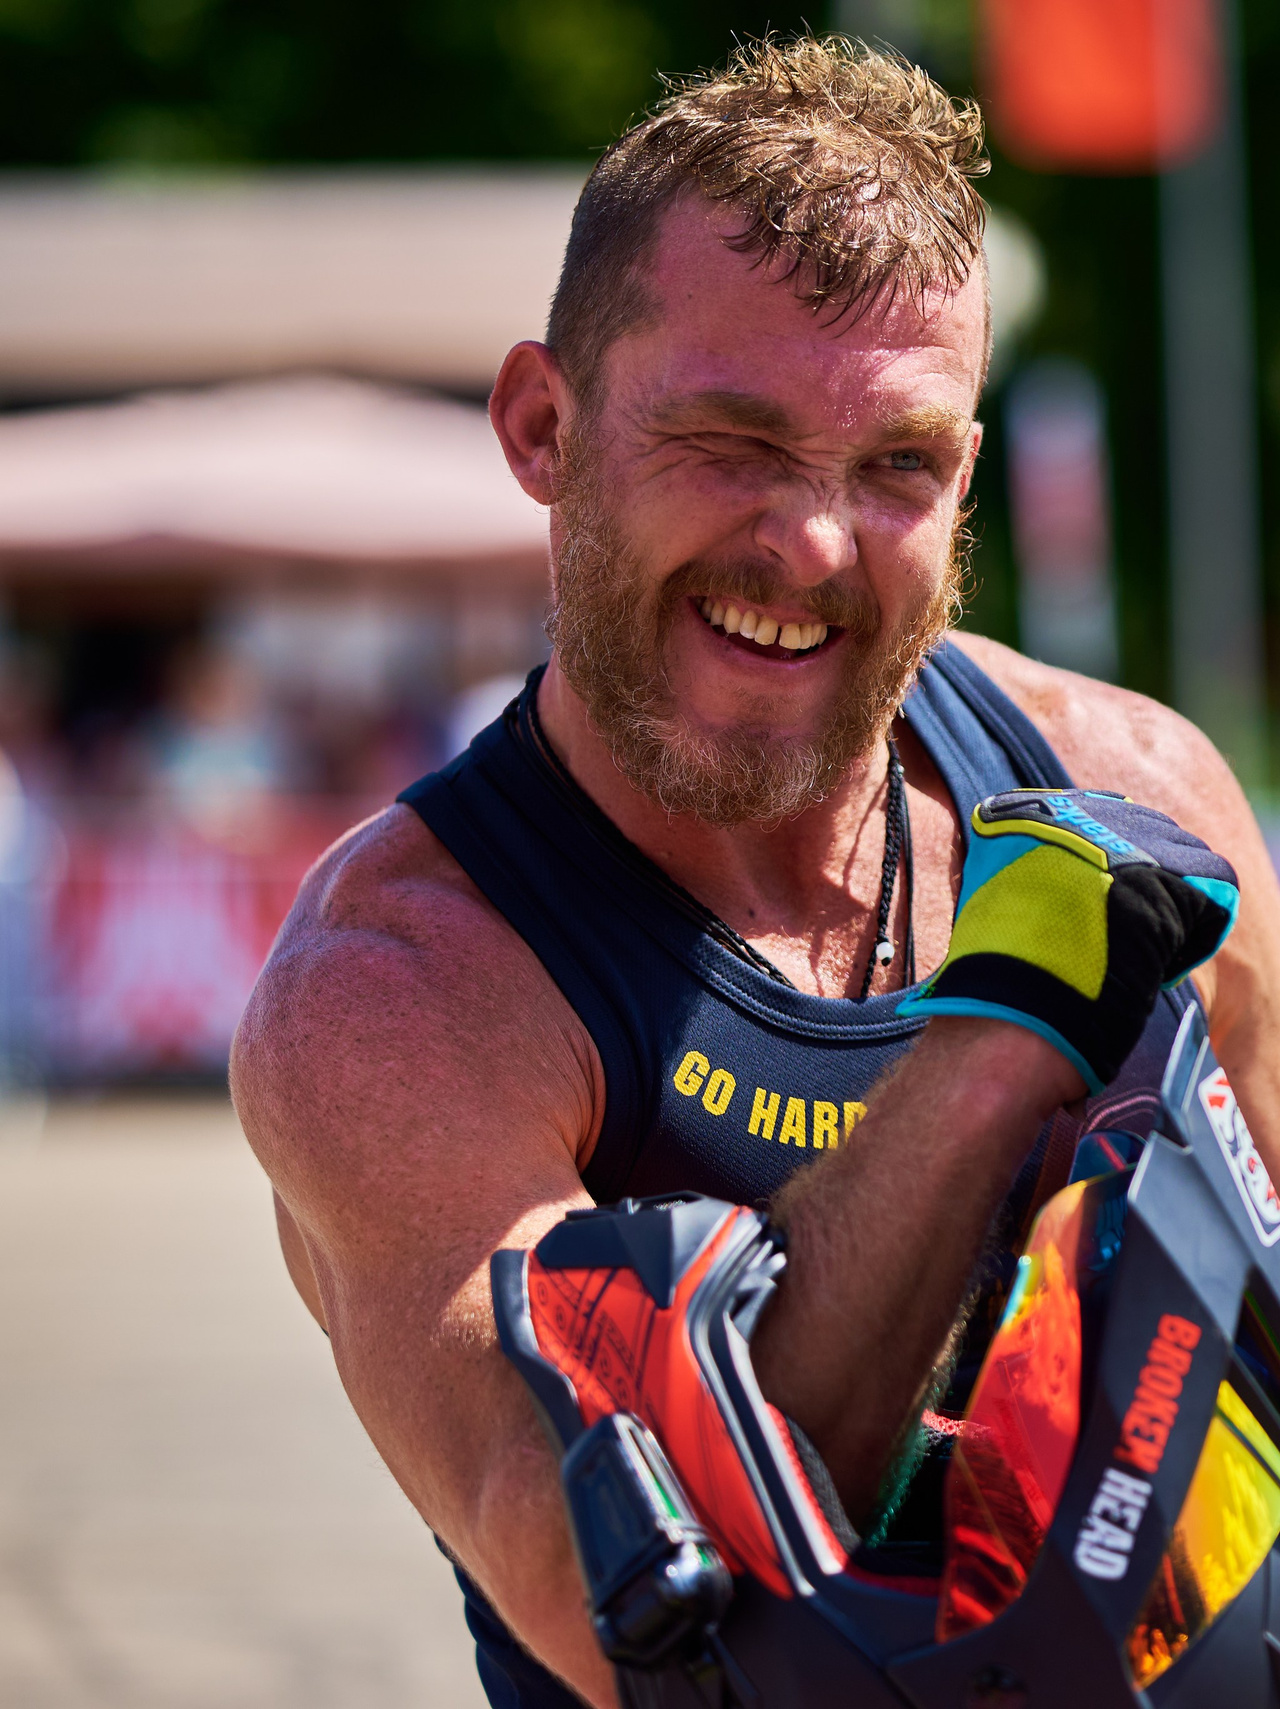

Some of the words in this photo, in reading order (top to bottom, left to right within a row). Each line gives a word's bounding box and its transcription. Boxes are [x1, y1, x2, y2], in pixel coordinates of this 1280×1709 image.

[673, 1050, 736, 1116] GO
[1112, 1312, 1203, 1474] BROKEN
[1074, 1467, 1153, 1580] HEAD
